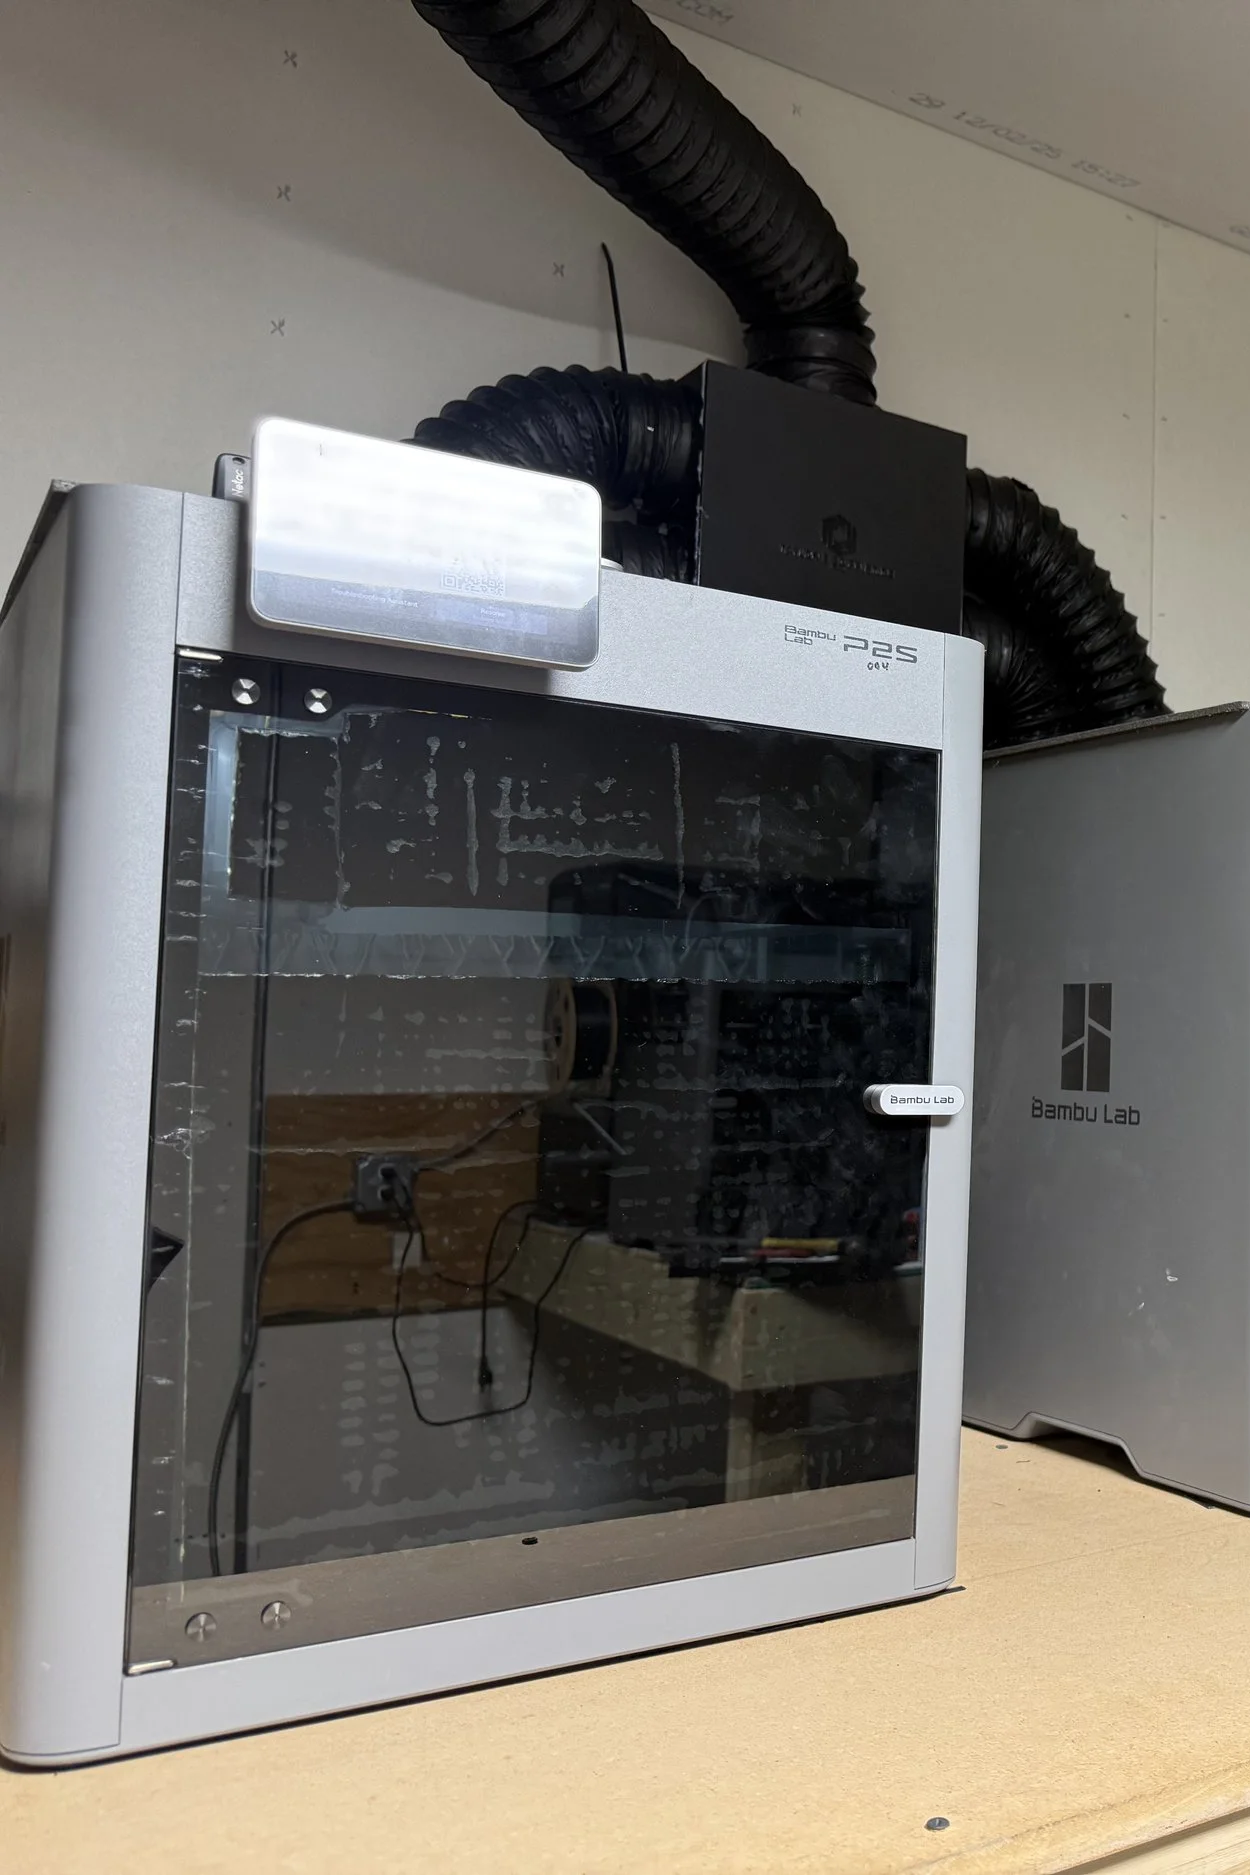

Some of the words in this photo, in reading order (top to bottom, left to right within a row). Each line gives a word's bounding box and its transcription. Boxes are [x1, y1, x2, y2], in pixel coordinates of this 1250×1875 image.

[231, 469, 244, 498] Netac
[784, 633, 813, 646] Lab
[784, 624, 837, 641] Bambu
[843, 635, 918, 664] P2S
[890, 1094, 931, 1104] Bambu
[934, 1096, 955, 1104] Lab
[1031, 1095, 1098, 1123] Bambu
[1103, 1103, 1141, 1126] Lab
